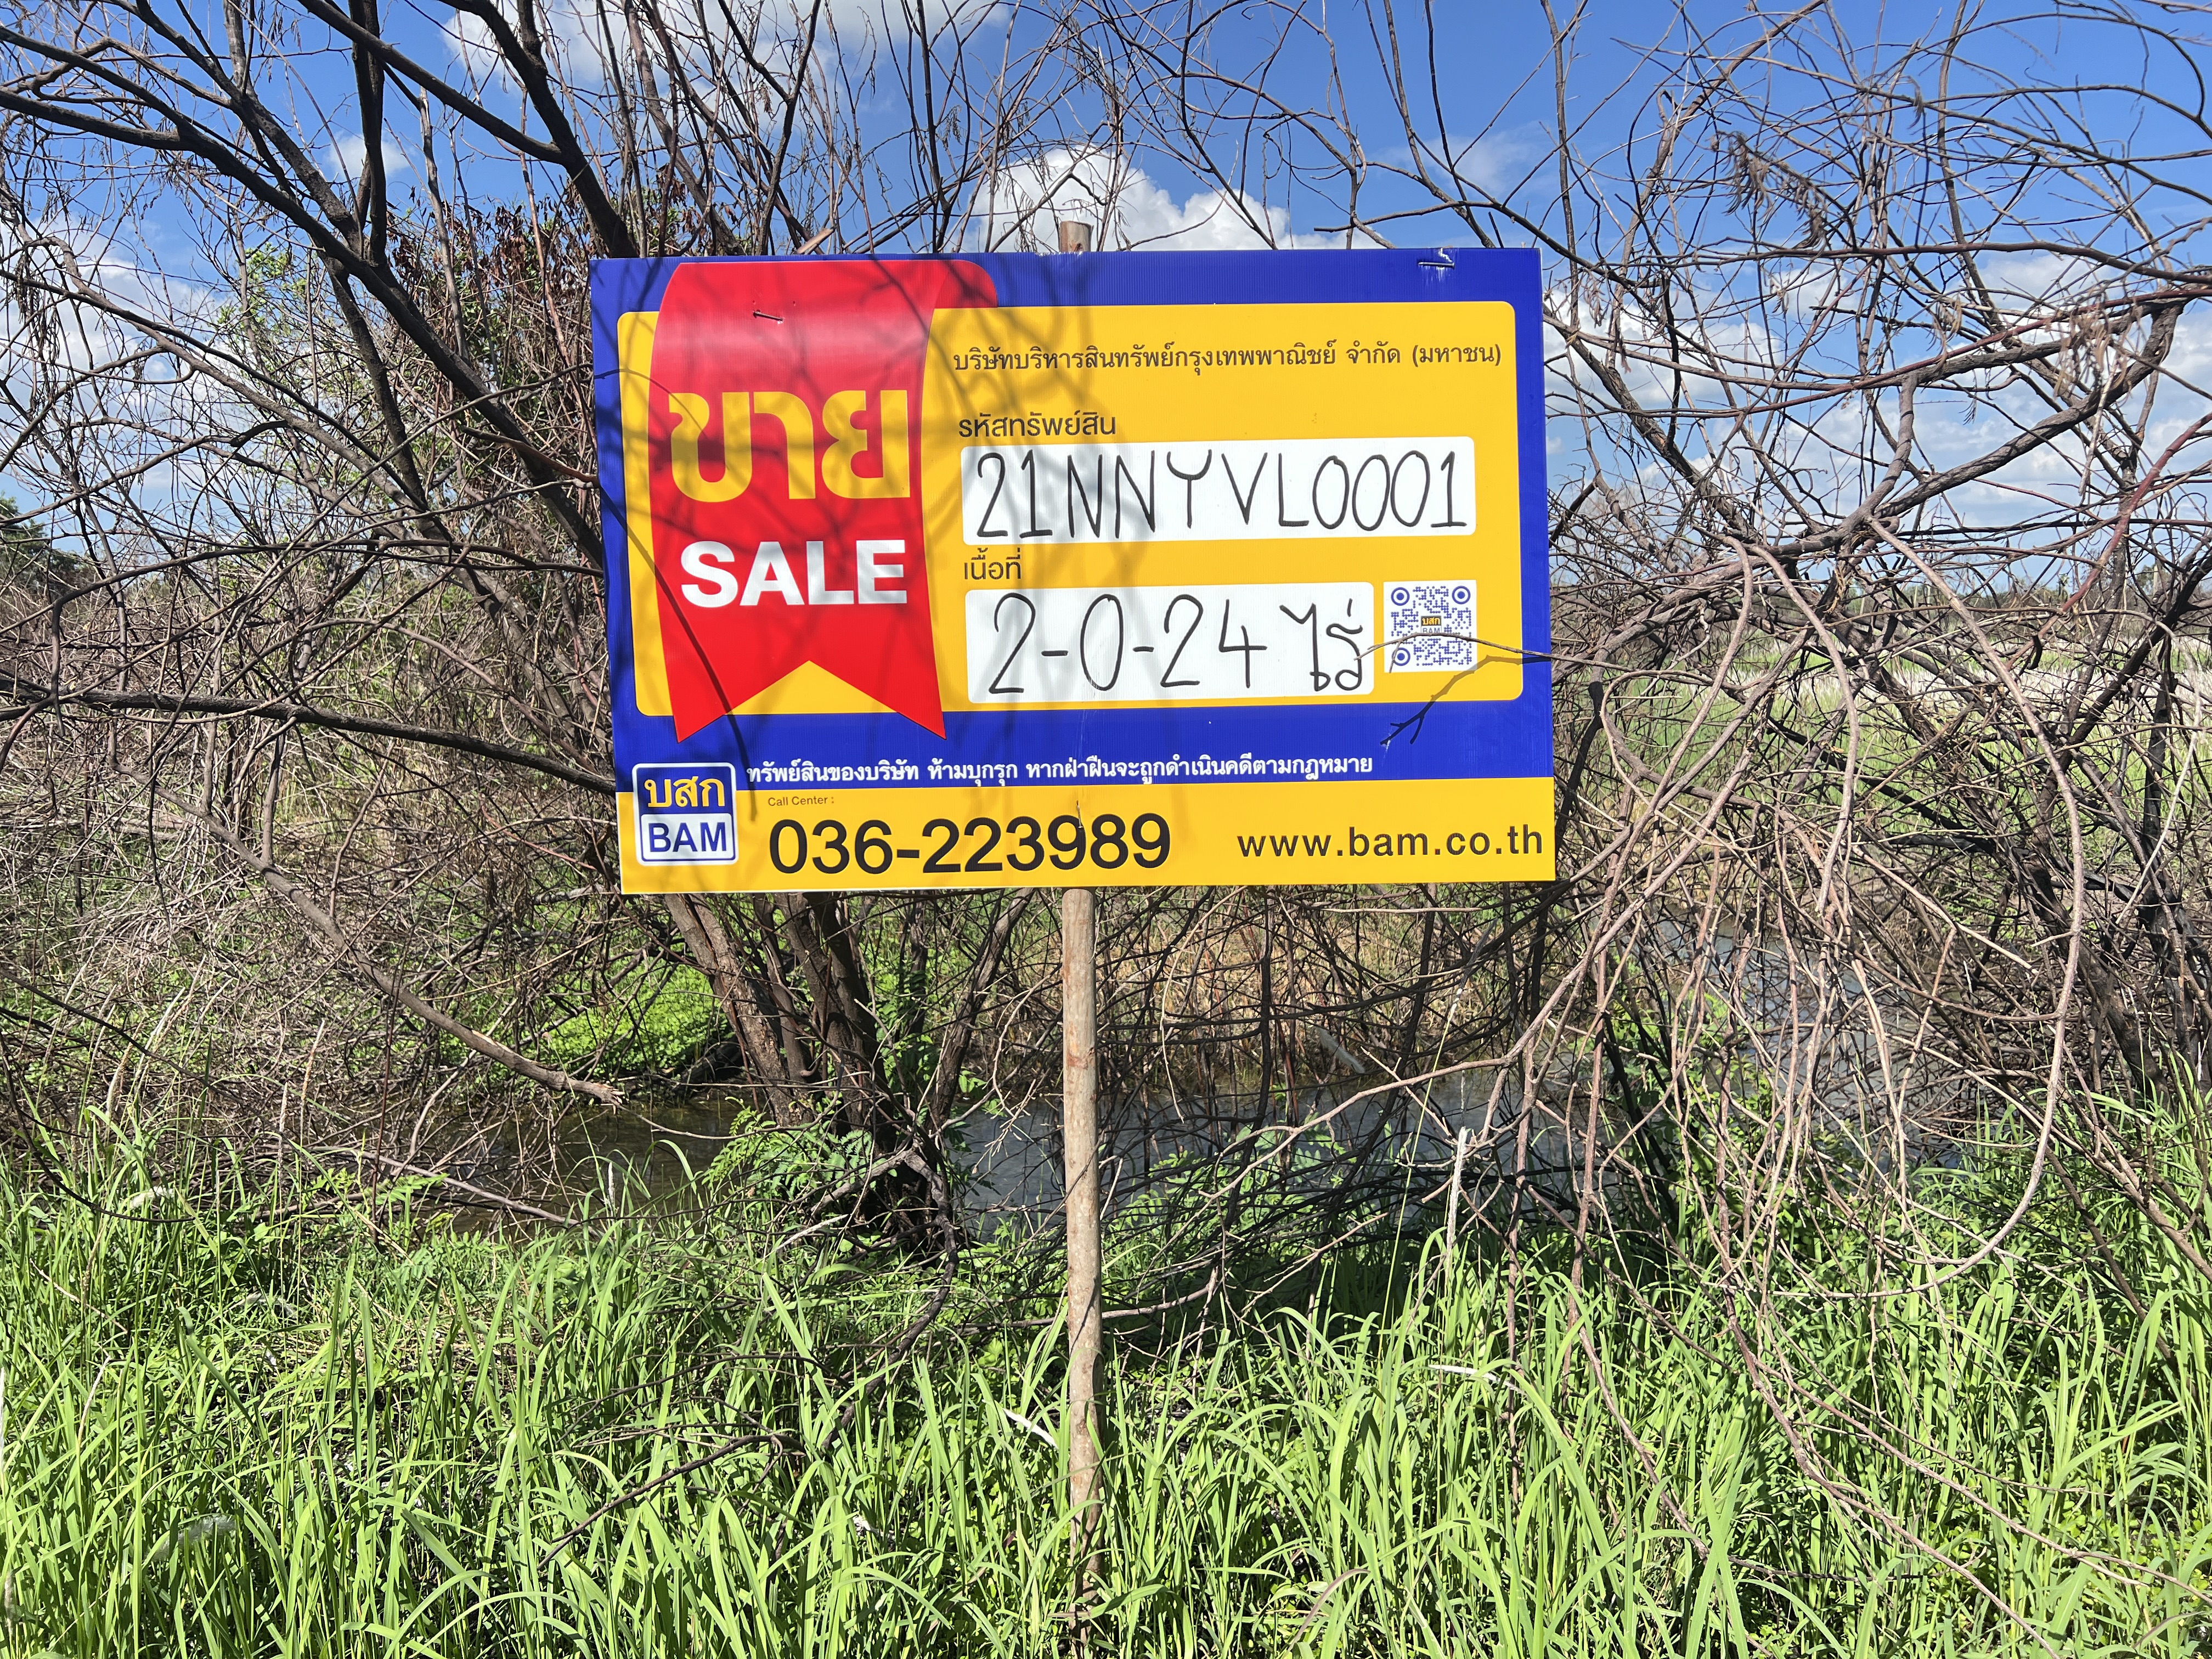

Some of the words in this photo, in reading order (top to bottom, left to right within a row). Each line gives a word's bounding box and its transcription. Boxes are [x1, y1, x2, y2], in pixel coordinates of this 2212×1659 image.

[953, 339, 1337, 375] บริษัทบริหารสินทรัพย์กรุงเทพพาณิชย์
[1346, 340, 1401, 364] จำกัด
[1412, 343, 1502, 367] (มหาชน)
[958, 410, 1116, 438] รหัสทรัพย์สิน
[669, 390, 910, 503] ขาย
[975, 449, 1467, 539] 21NNYVL0001
[680, 539, 907, 607] SALE
[963, 546, 1022, 580] เนื้อที่
[988, 592, 1267, 694] 2-0-24
[747, 759, 919, 782] ทรัพย์สินของบริษัท
[928, 758, 1018, 786] ห้ามบุกรุก
[1026, 752, 1372, 785] หากฝ่าฝืนจะถูกดำเนินคดีตามกฎหมาย
[645, 776, 725, 808] บสก
[768, 797, 788, 806] Call
[792, 795, 828, 805] Center
[648, 822, 726, 853] BAM
[769, 813, 1171, 874] 036-223989
[1237, 824, 1543, 857] www.bam.co.th
